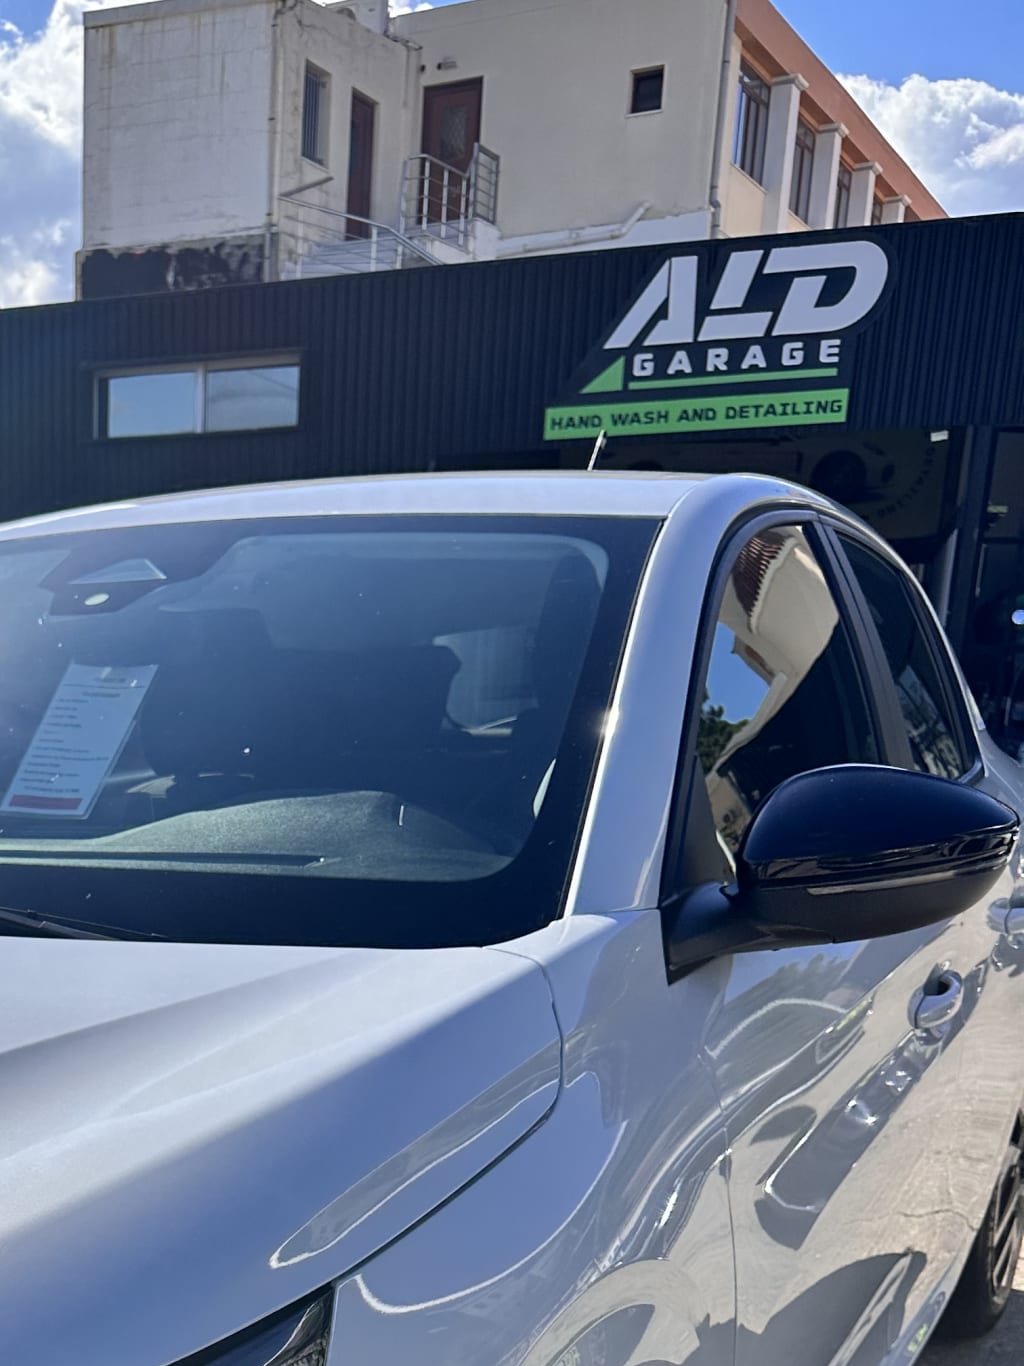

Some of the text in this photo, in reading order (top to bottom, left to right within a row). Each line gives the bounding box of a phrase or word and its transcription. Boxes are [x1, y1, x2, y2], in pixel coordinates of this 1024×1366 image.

[603, 240, 889, 349] ALD
[632, 338, 842, 377] GARAGE
[550, 398, 843, 432] HAND WASH AND DETAILING
